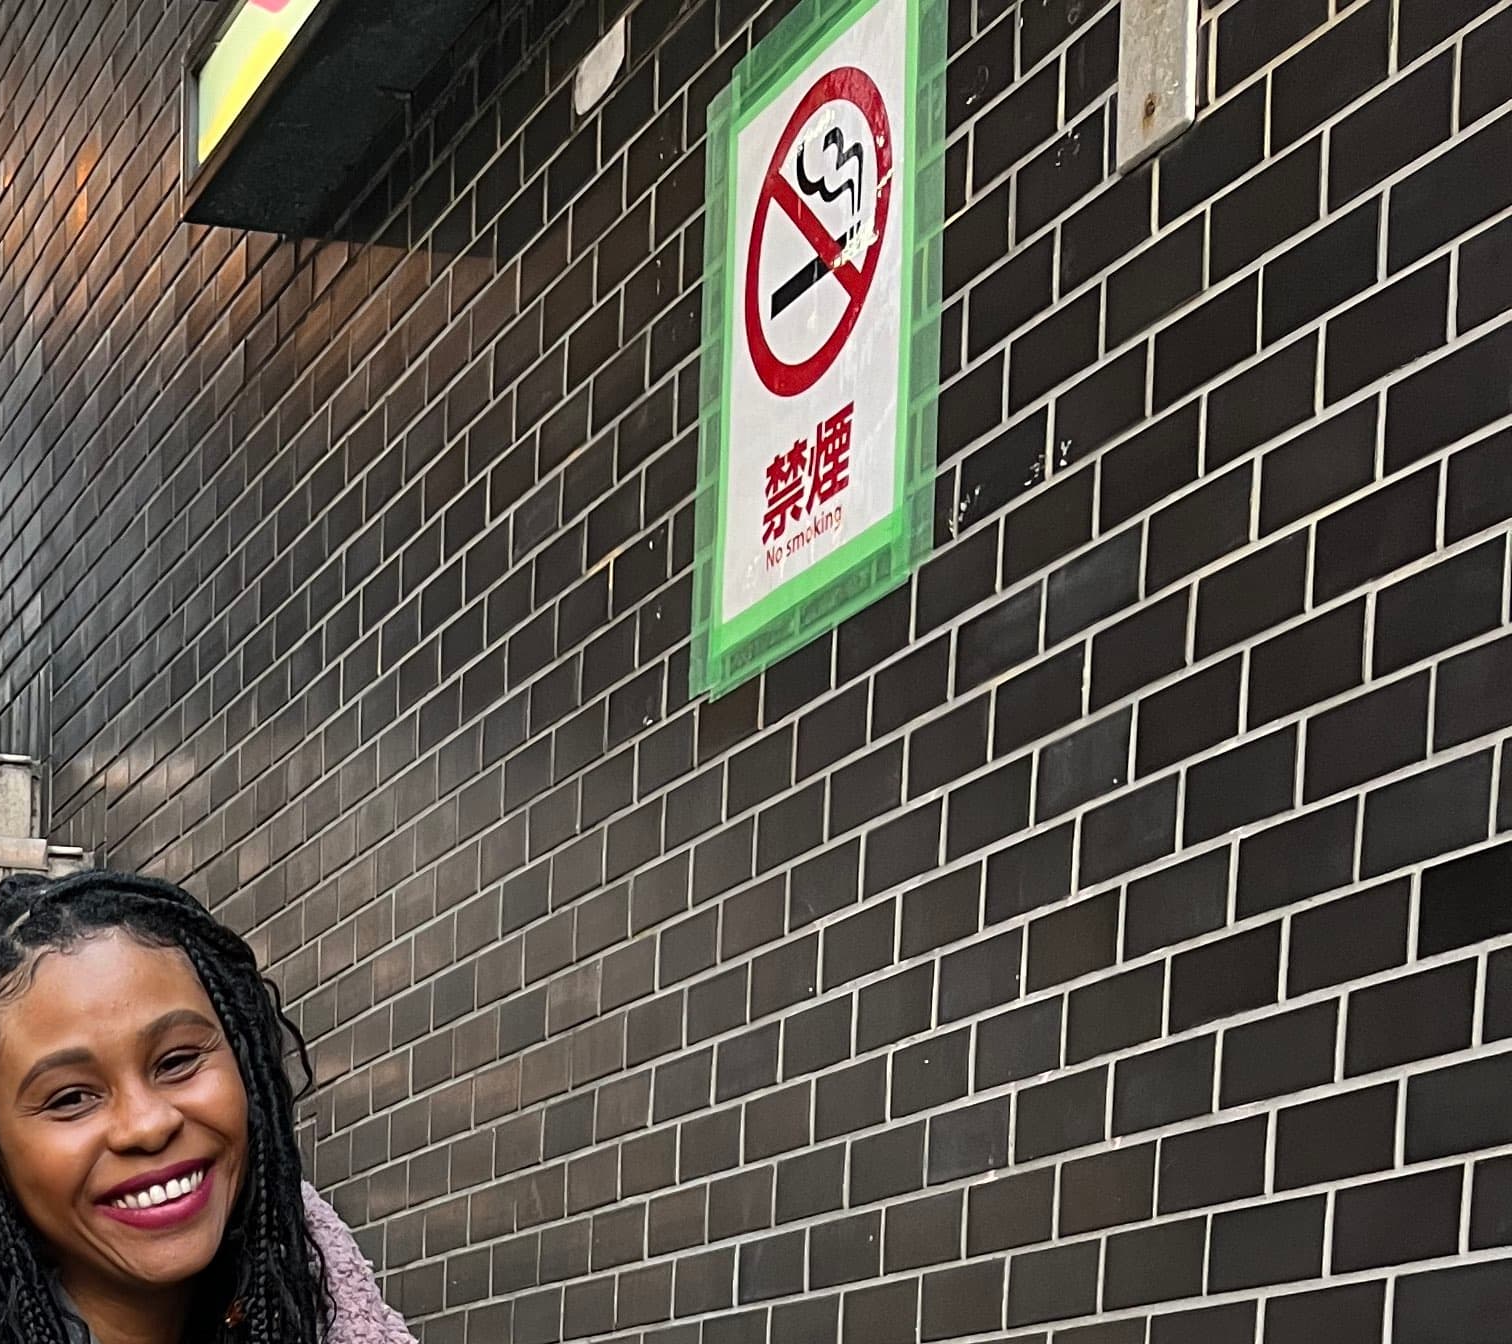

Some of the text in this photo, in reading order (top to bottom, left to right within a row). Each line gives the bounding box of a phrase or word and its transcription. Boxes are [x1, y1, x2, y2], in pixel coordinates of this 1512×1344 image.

[762, 400, 855, 545] 禁煙
[765, 506, 842, 571] No smoking
